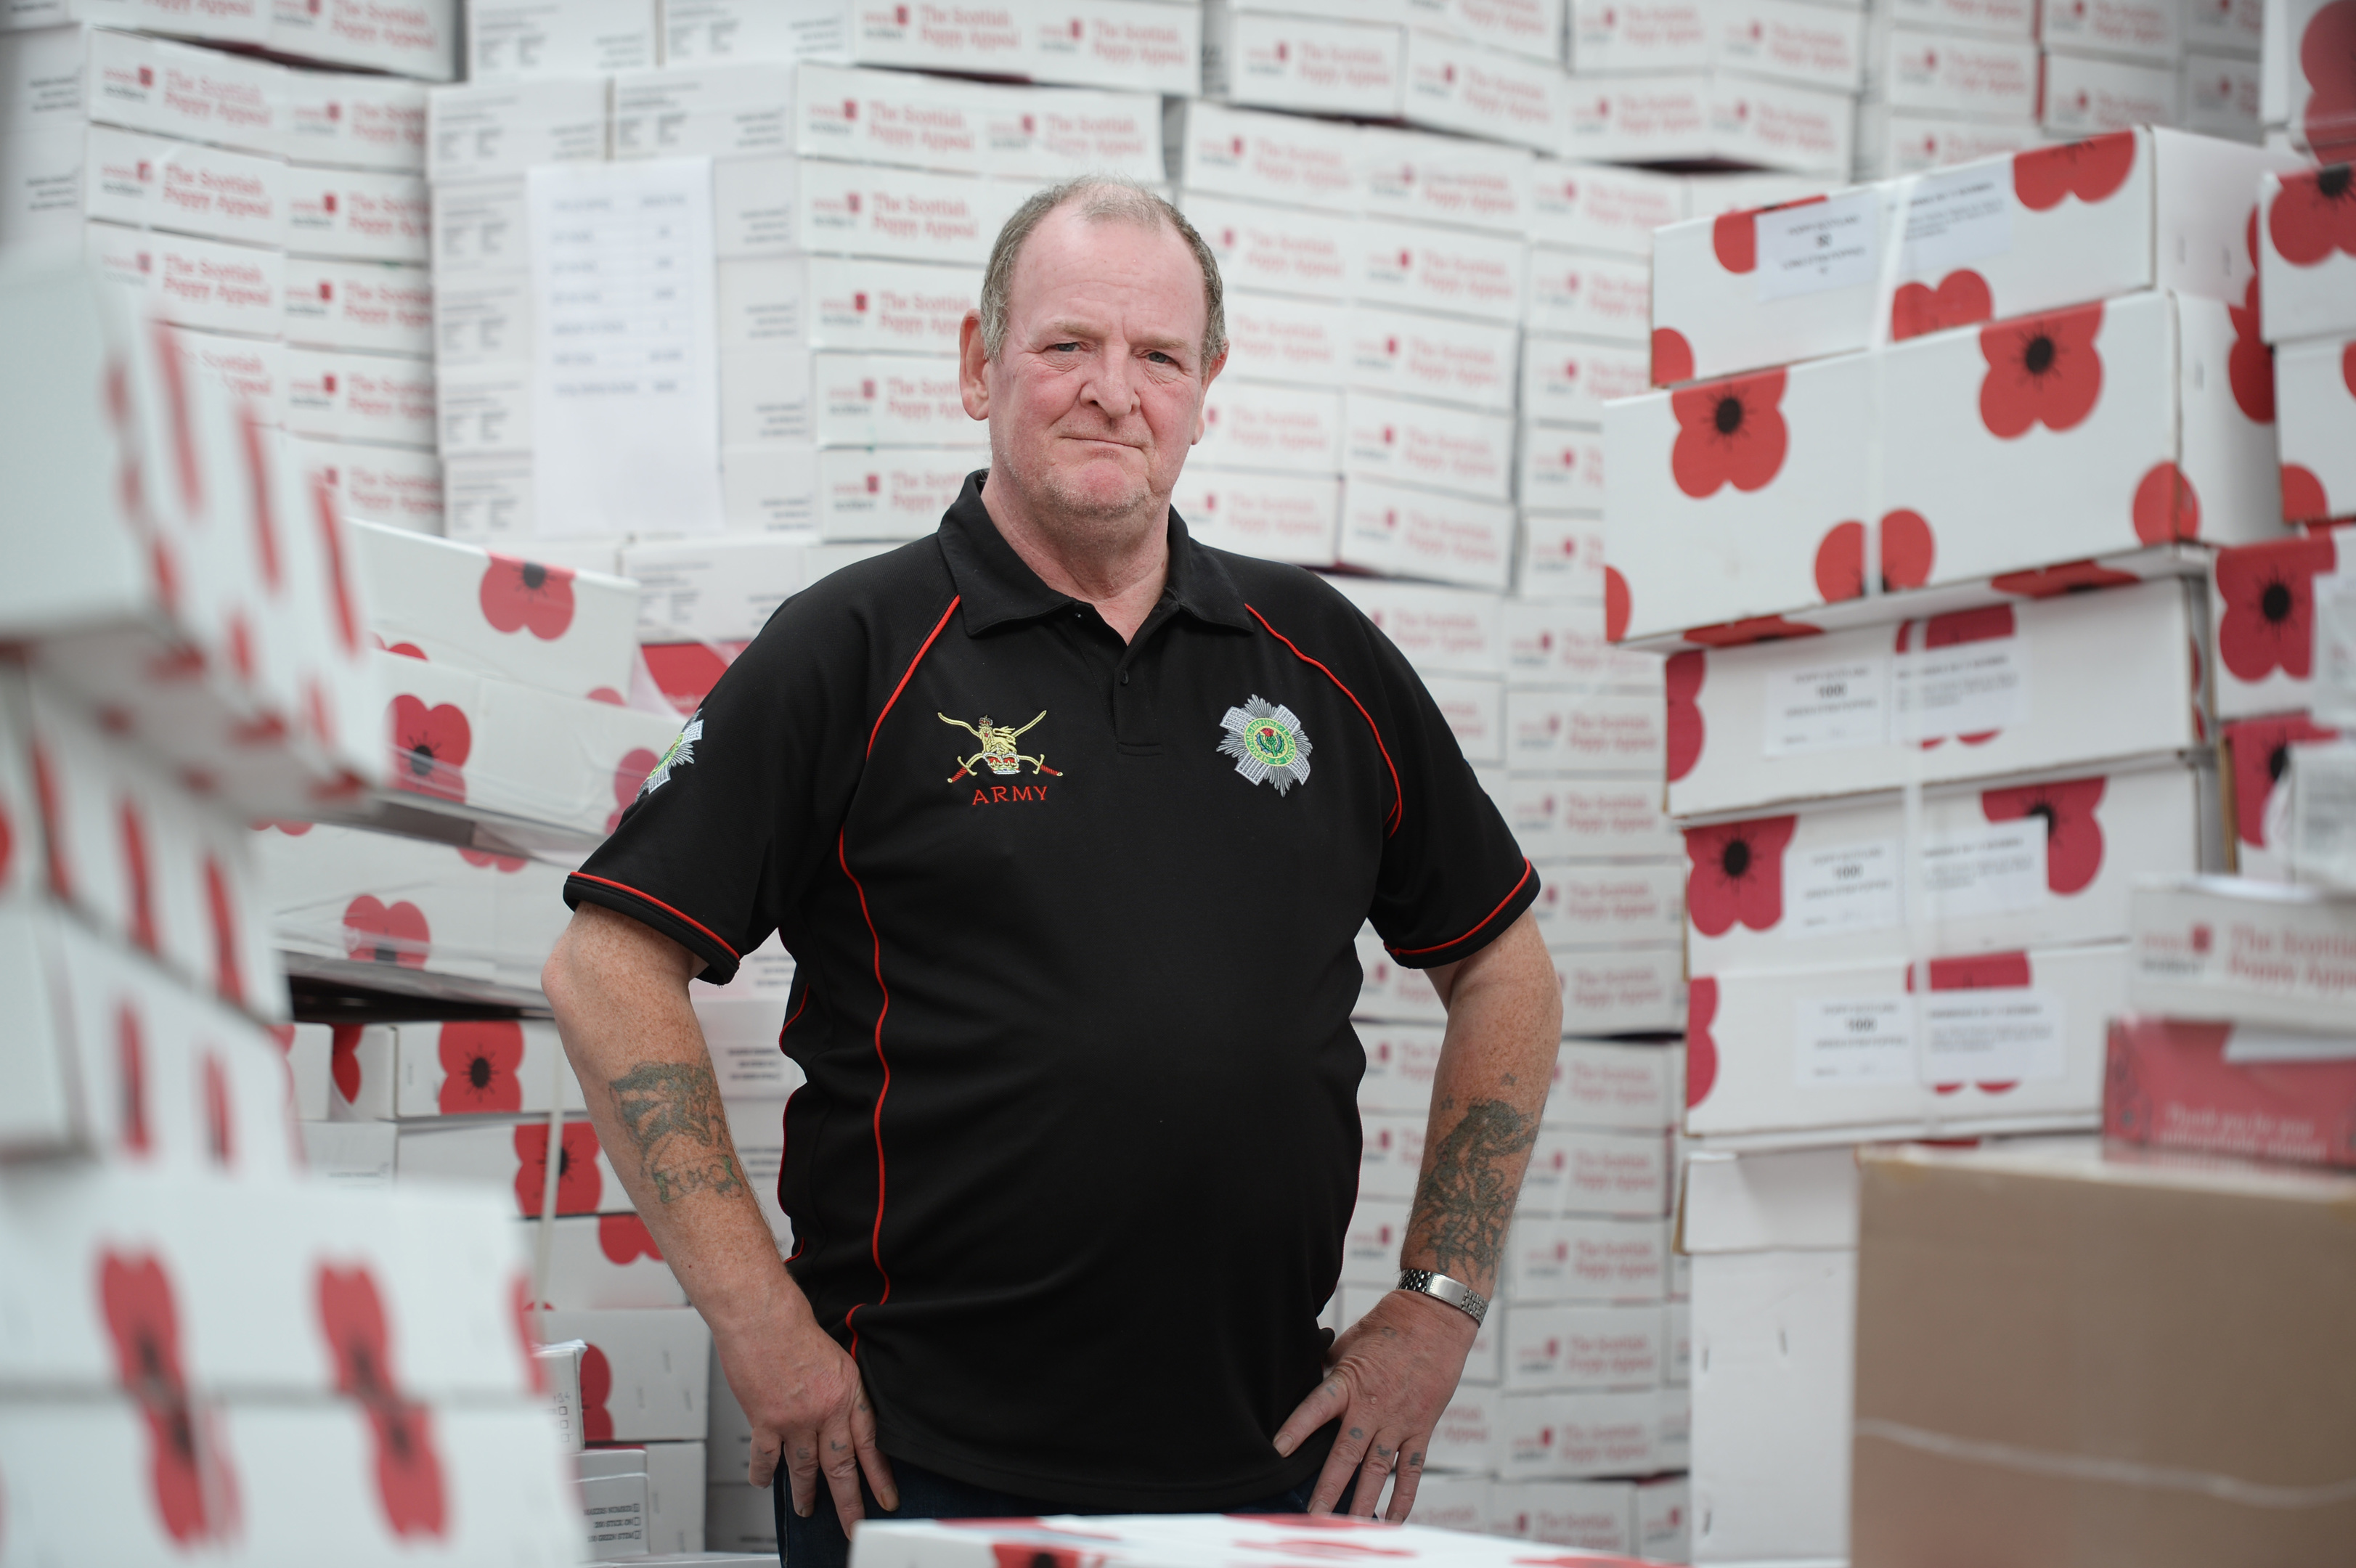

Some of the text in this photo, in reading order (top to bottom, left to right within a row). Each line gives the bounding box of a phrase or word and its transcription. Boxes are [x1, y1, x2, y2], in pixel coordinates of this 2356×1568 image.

[920, 4, 1012, 27] The Scottish
[921, 24, 1021, 50] Poppy Appeal
[1094, 18, 1178, 43] The Scottish
[1093, 38, 1186, 66] Poppy Appeal
[166, 67, 261, 104] The Scottish
[163, 90, 274, 126] Poppy Appeal
[870, 100, 964, 128] The Scottish
[869, 120, 974, 151] Poppy Appeal
[1046, 113, 1135, 134] The Scottish
[1043, 134, 1144, 158] Poppy Appeal
[165, 163, 263, 195] The Scottish
[163, 180, 272, 219] Poppy Appeal
[873, 192, 969, 217] The Scottish
[873, 211, 979, 240] Poppy Appeal
[164, 254, 262, 283] The Scottish
[163, 271, 272, 306] Poppy Appeal
[880, 290, 908, 310] The
[879, 310, 924, 335] Poppy
[887, 377, 916, 396] The
[887, 396, 932, 420] Poppy
[892, 470, 918, 489] The
[892, 490, 934, 513] Poppy
[1251, 719, 1279, 731] IMPUNE
[972, 785, 1048, 806] ARMY
[2231, 923, 2273, 952] The
[2227, 951, 2296, 984] Poppy
[608, 1505, 632, 1514] NUMBER
[618, 1532, 635, 1540] STEM
